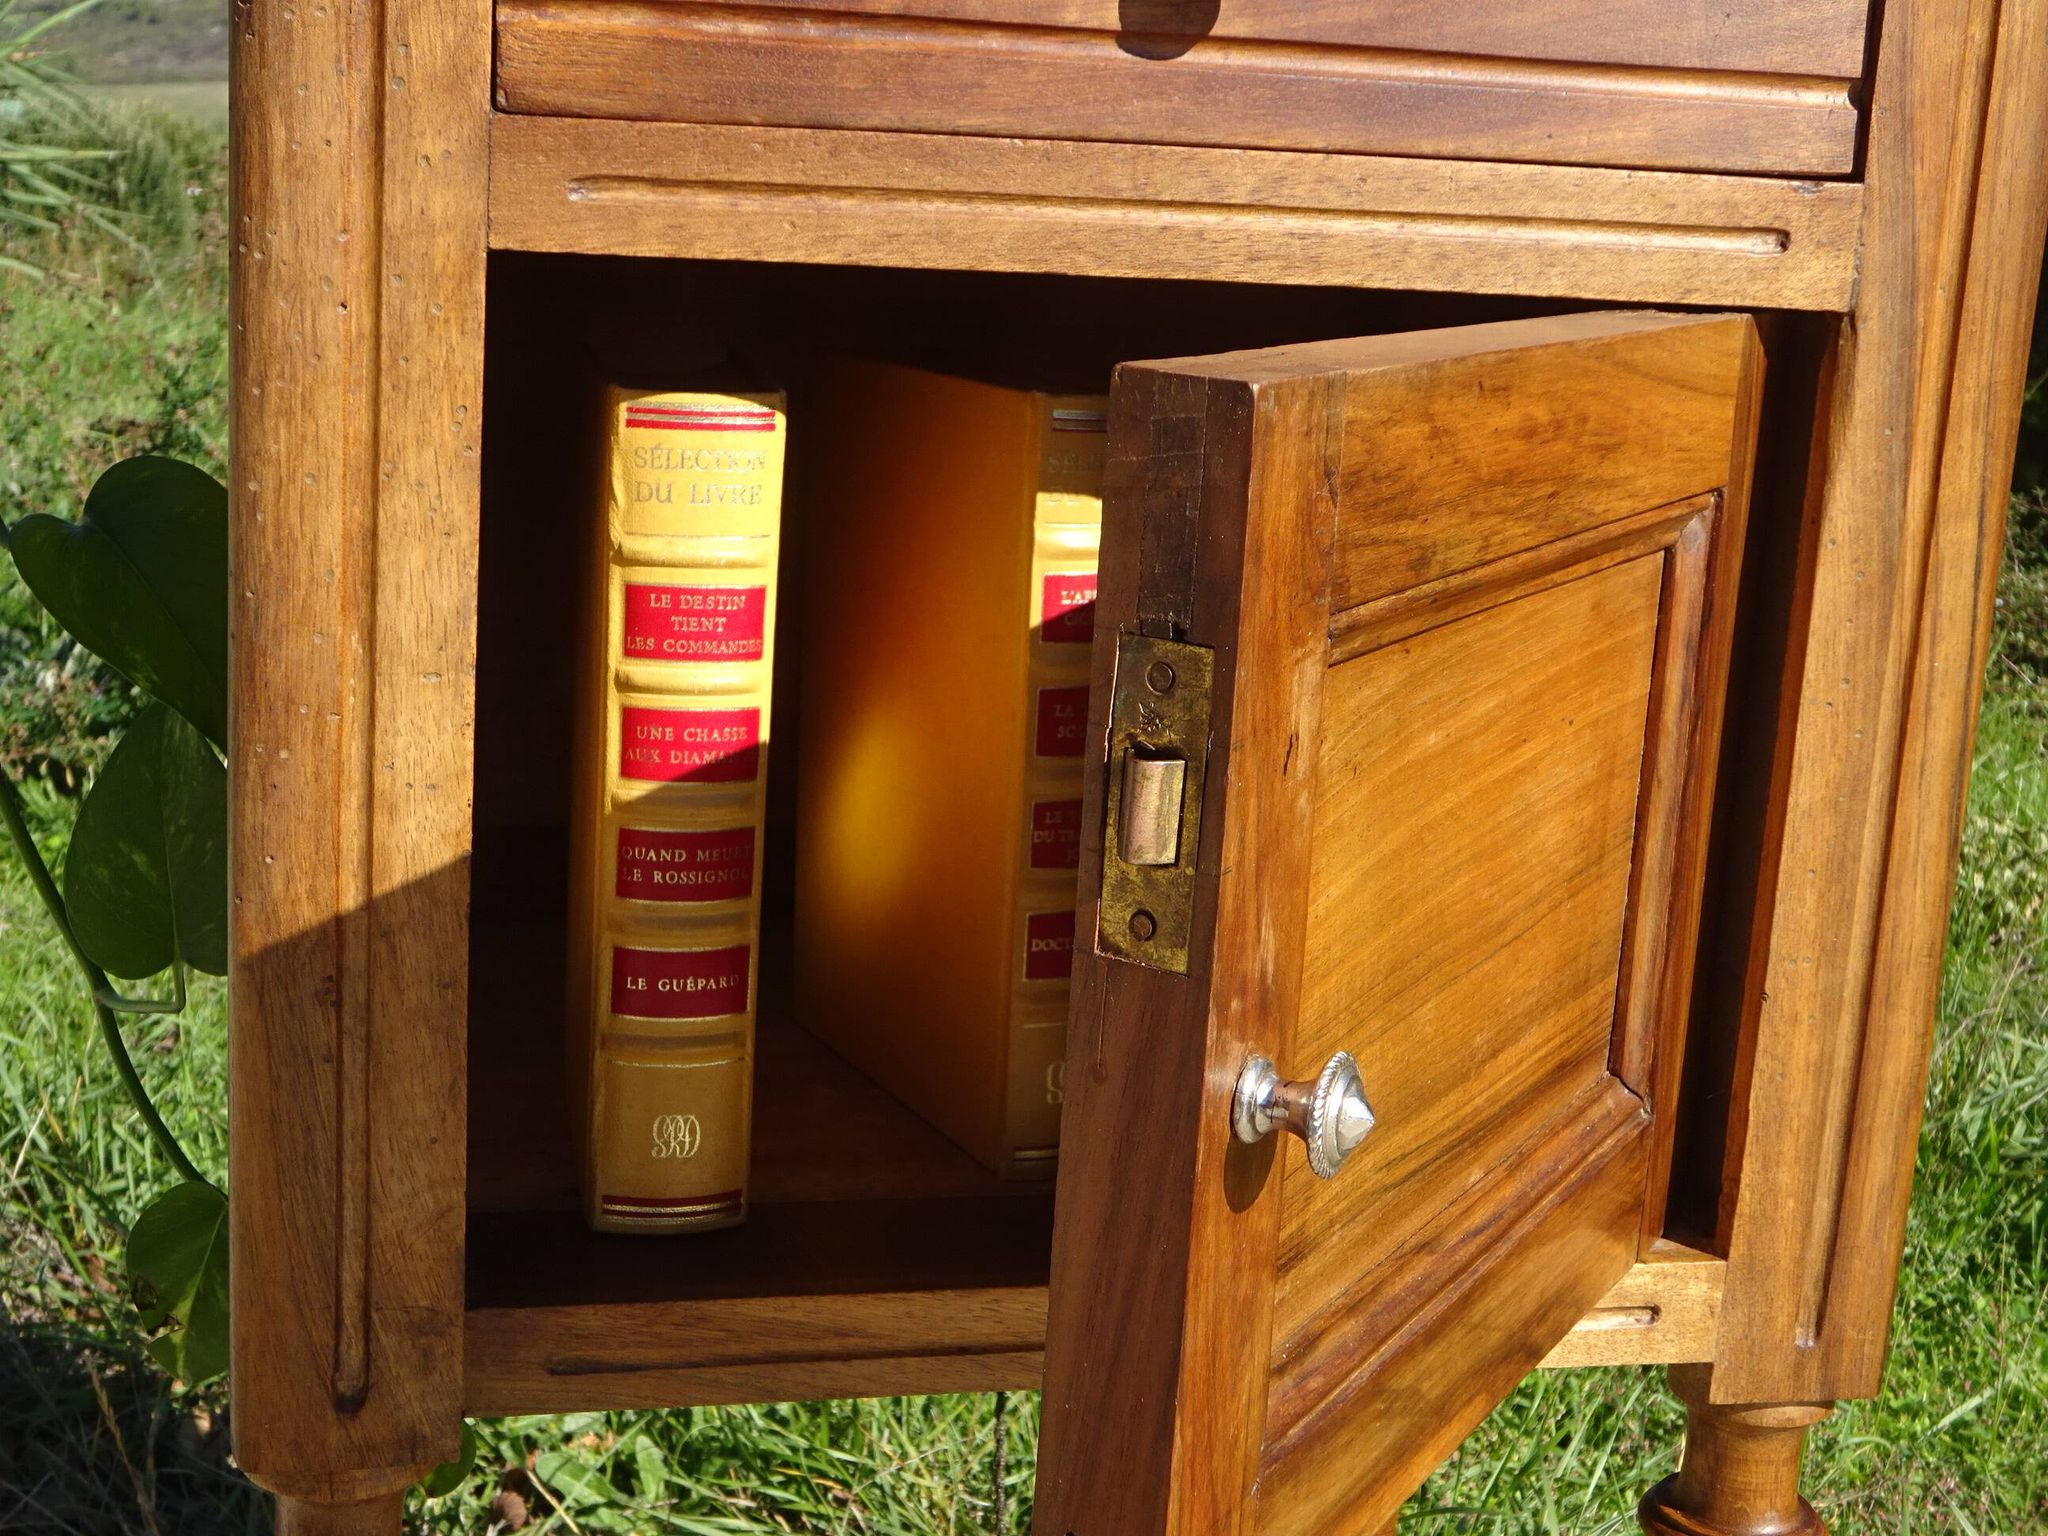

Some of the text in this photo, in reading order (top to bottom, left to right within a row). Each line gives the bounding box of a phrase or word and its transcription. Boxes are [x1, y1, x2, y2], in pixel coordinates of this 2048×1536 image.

[634, 443, 768, 471] SÉLECTION
[635, 480, 762, 505] DU LIVRE
[649, 593, 746, 610] LE DESTIN
[671, 616, 726, 632] TIENT
[627, 636, 762, 654] LES COMMANDES
[636, 726, 748, 742] UNE CHASSE
[626, 748, 660, 763] AUX
[623, 847, 687, 862] QUAND
[623, 868, 642, 881] LE
[627, 975, 739, 991] LE GUÉPARD
